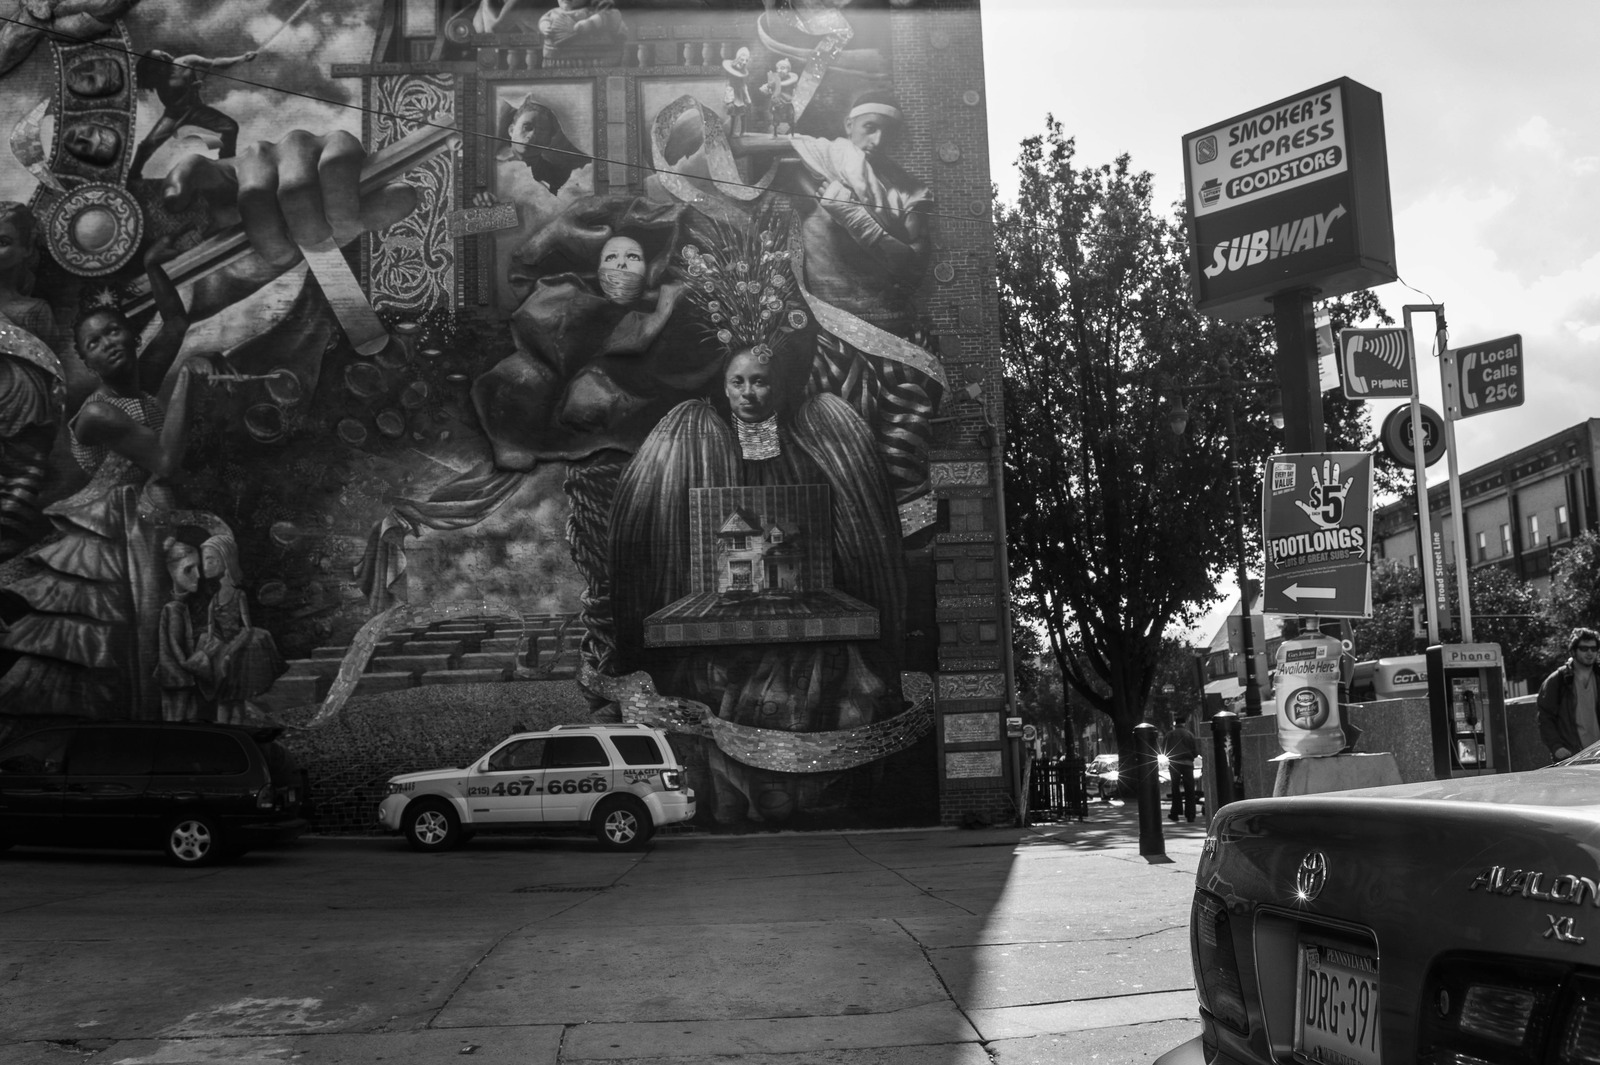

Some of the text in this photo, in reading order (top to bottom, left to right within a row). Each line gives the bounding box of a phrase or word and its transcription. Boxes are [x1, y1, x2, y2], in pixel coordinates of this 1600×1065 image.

[1228, 93, 1332, 147] SMOKER'S
[1229, 118, 1335, 169] EXPRESS
[1232, 149, 1336, 197] FOODSTORE
[1203, 203, 1347, 280] SUBWAY
[1480, 344, 1518, 365] Local
[1482, 364, 1518, 382] Calls
[1371, 379, 1408, 389] PHNE
[1275, 477, 1294, 489] VALUE
[1271, 526, 1364, 559] FOOTLONGS
[1298, 555, 1306, 565] OF
[1307, 552, 1328, 563] GREAT
[1330, 549, 1350, 560] SUBS
[1433, 532, 1446, 602] Broad Street Line
[1451, 651, 1491, 661] Phone
[1280, 660, 1335, 675] Available Here
[1394, 673, 1417, 684] CCT
[468, 786, 490, 797] (215)
[1468, 865, 1600, 907] AVALON
[1543, 913, 1585, 943] XL
